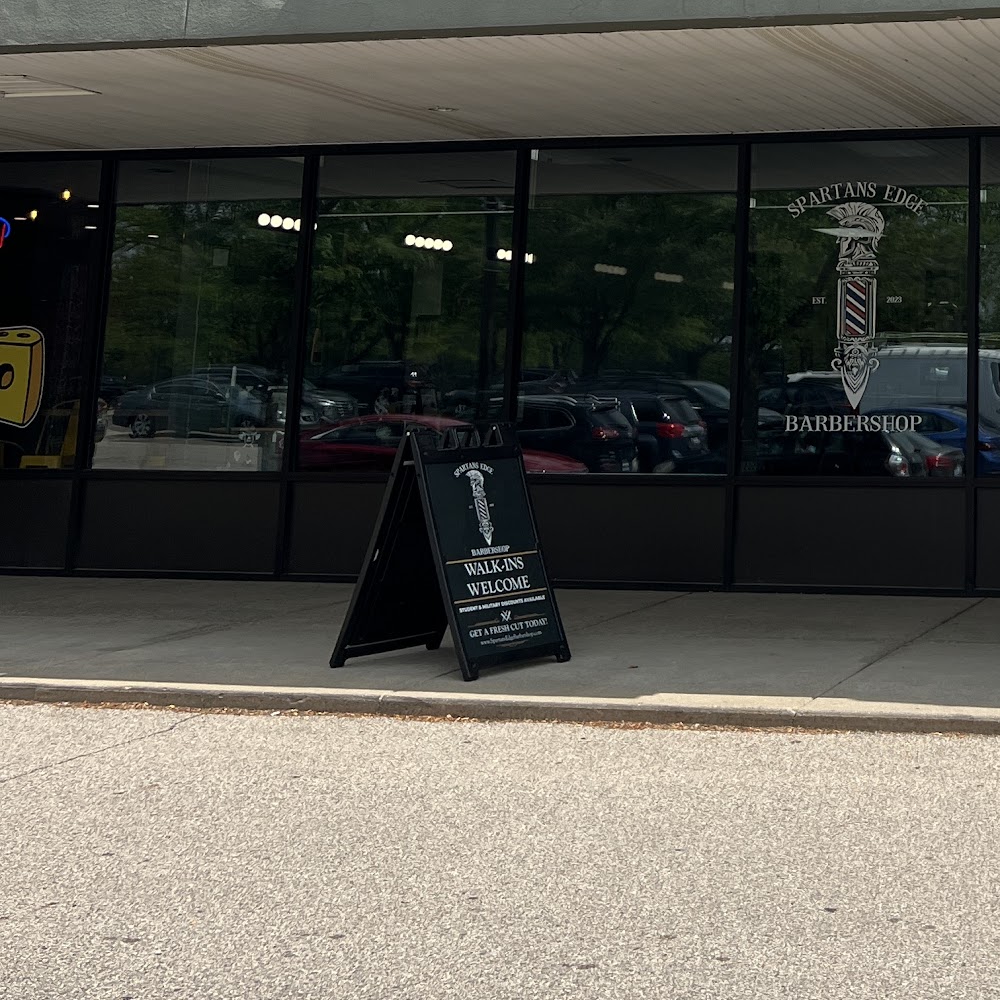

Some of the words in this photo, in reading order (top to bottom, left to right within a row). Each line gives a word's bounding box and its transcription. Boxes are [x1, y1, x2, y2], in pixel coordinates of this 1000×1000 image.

[787, 181, 877, 218] SPARTANS
[883, 184, 929, 216] EDGE
[785, 415, 922, 432] BARBERSHOP
[453, 461, 479, 478] SPARTANS
[479, 462, 495, 475] EDGE
[471, 545, 510, 557] BARBERSHOP
[464, 556, 525, 577] WALK-INS
[466, 575, 531, 597] WELCOME
[459, 605, 478, 613] STUDENT
[482, 602, 501, 610] MILITARY
[501, 598, 523, 607] DISCOUNTS
[469, 628, 484, 638] GET
[484, 627, 490, 636] A
[489, 623, 510, 635] FRESH
[510, 621, 524, 631] CUT
[525, 617, 548, 628] TODAY!
